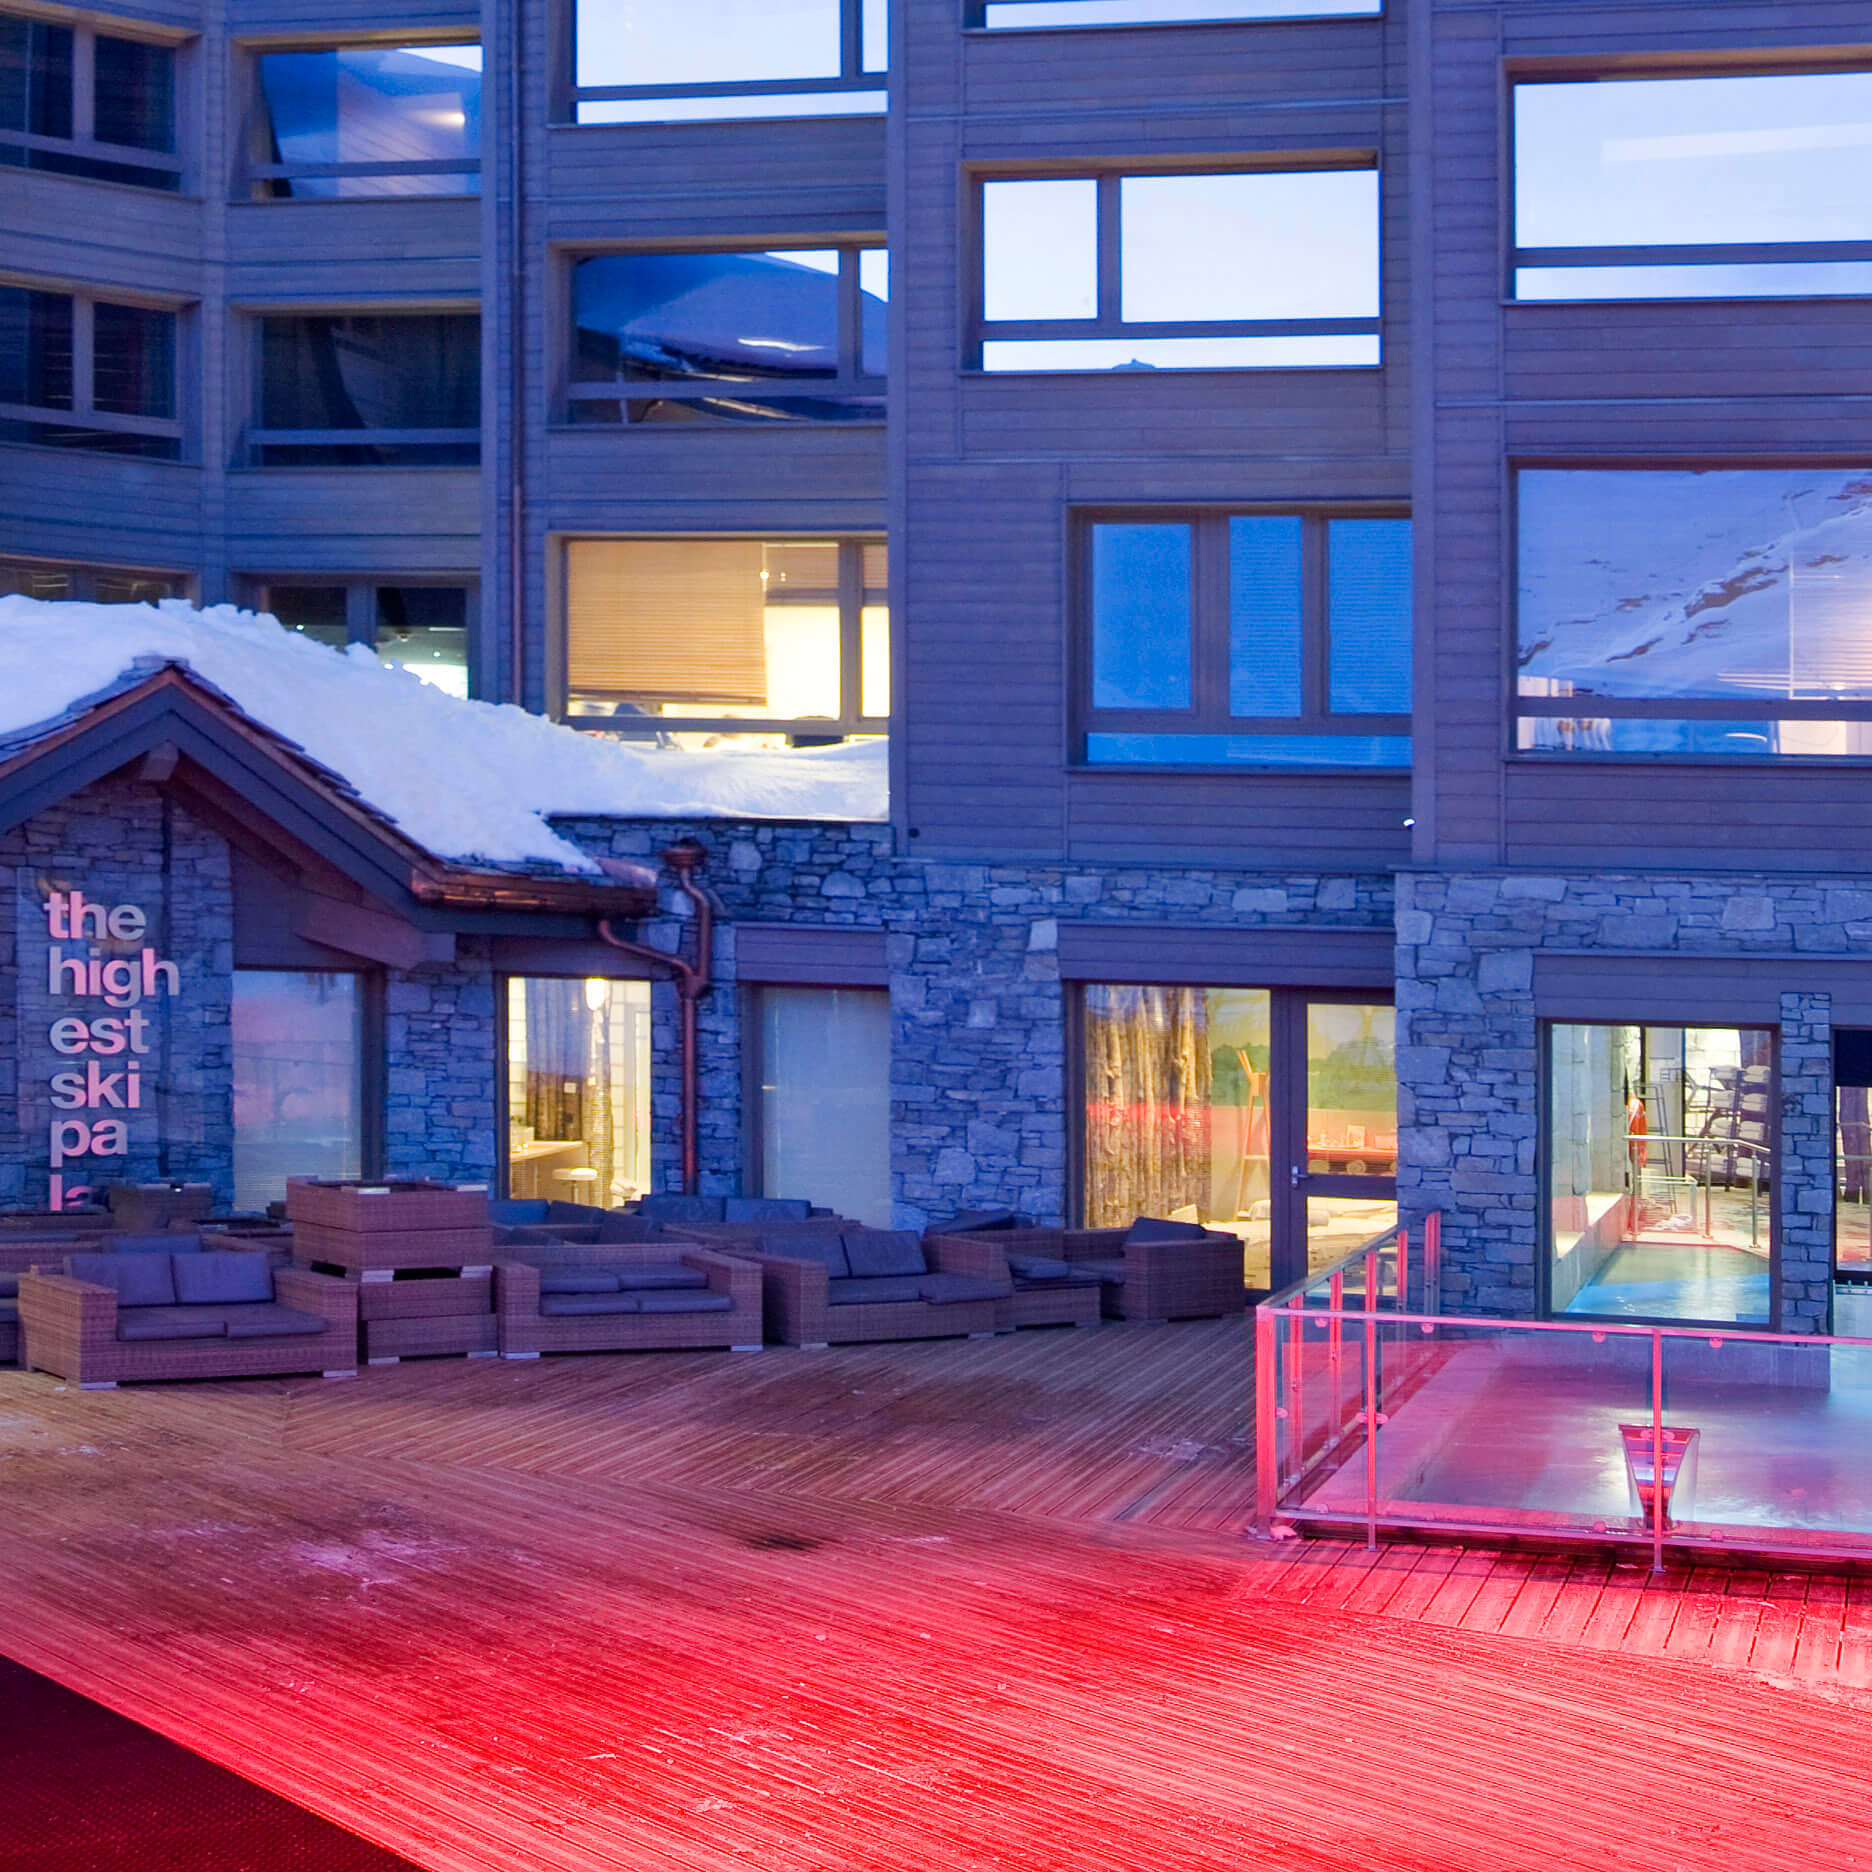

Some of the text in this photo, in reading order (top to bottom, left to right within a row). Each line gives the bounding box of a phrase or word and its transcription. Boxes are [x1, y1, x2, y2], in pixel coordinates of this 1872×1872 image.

[43, 890, 146, 940] the
[49, 946, 180, 1008] high
[49, 1009, 150, 1055] est
[50, 1060, 141, 1110] ski
[49, 1118, 129, 1168] pa
